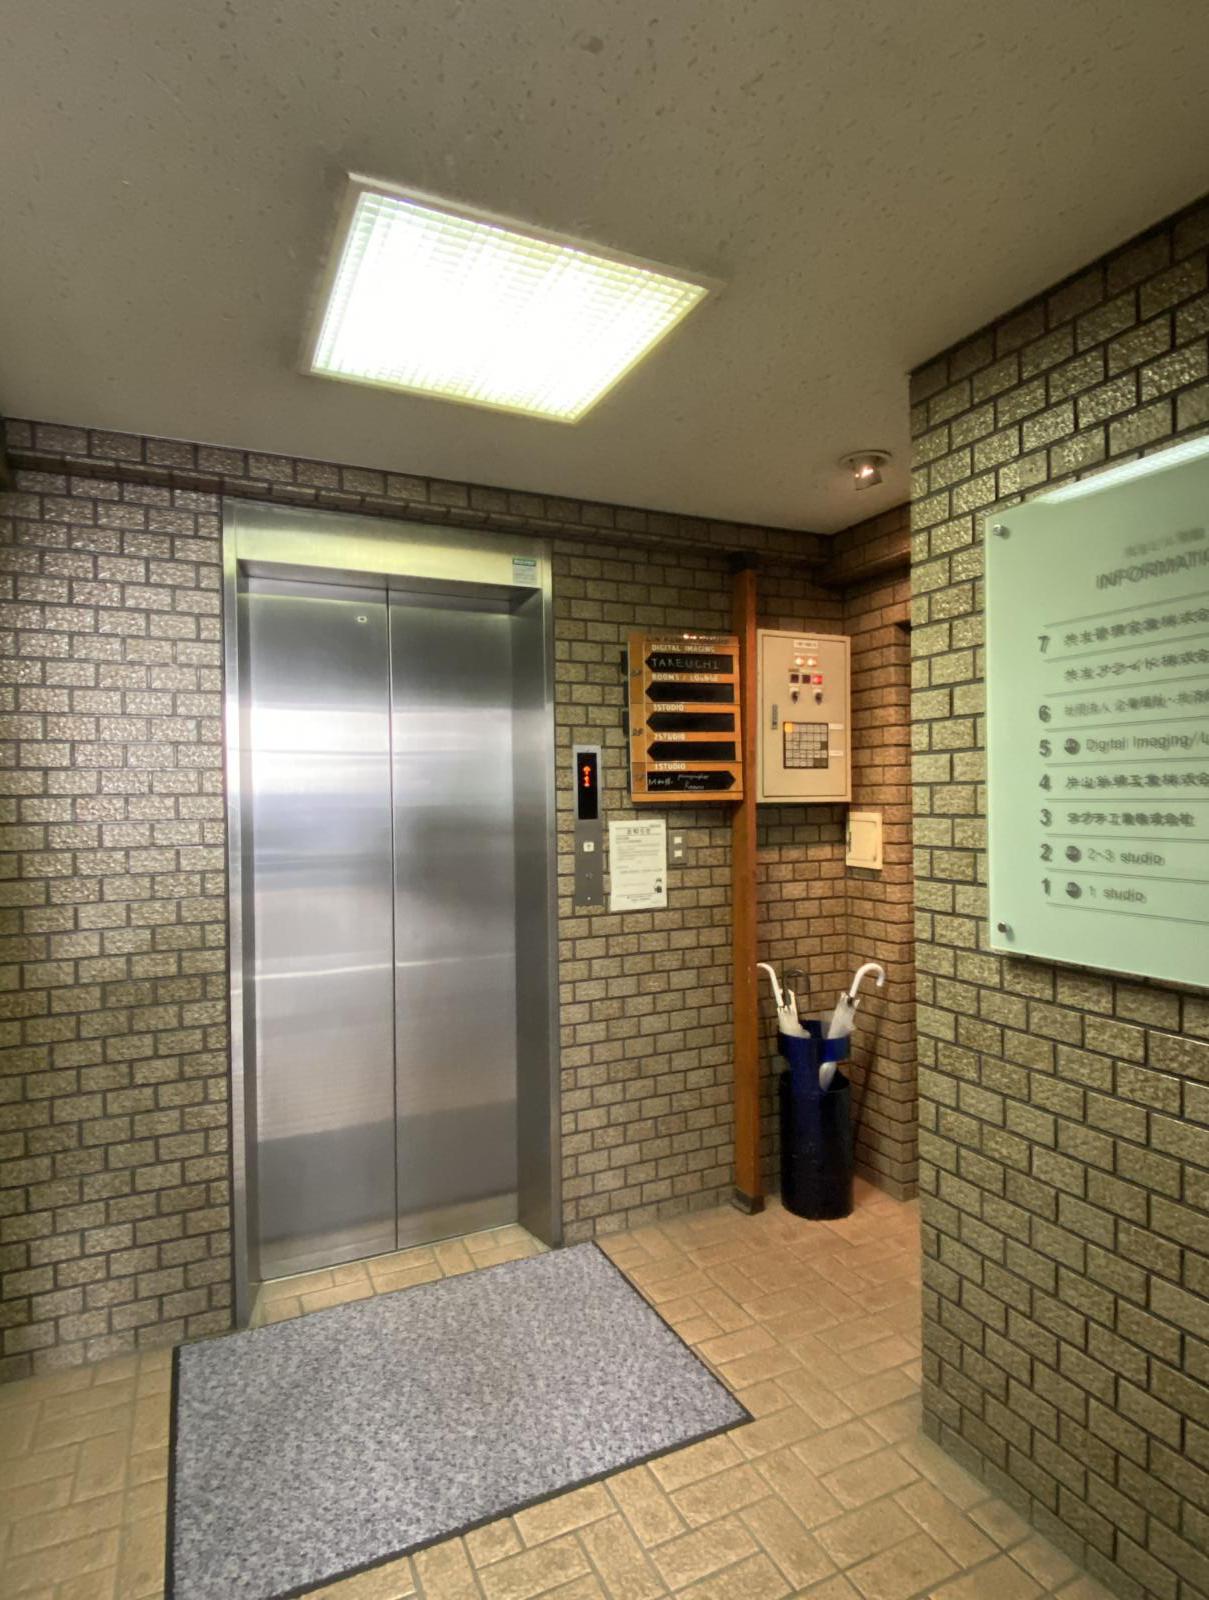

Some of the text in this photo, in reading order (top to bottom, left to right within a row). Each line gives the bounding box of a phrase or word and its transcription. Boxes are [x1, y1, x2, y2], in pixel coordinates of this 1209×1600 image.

[1038, 635, 1049, 653] 7
[1039, 704, 1051, 723] 6
[1039, 739, 1052, 757] 5
[1039, 774, 1052, 791] 4
[1040, 808, 1052, 827] 3
[1040, 843, 1052, 862] 2
[1041, 877, 1051, 896] 1
